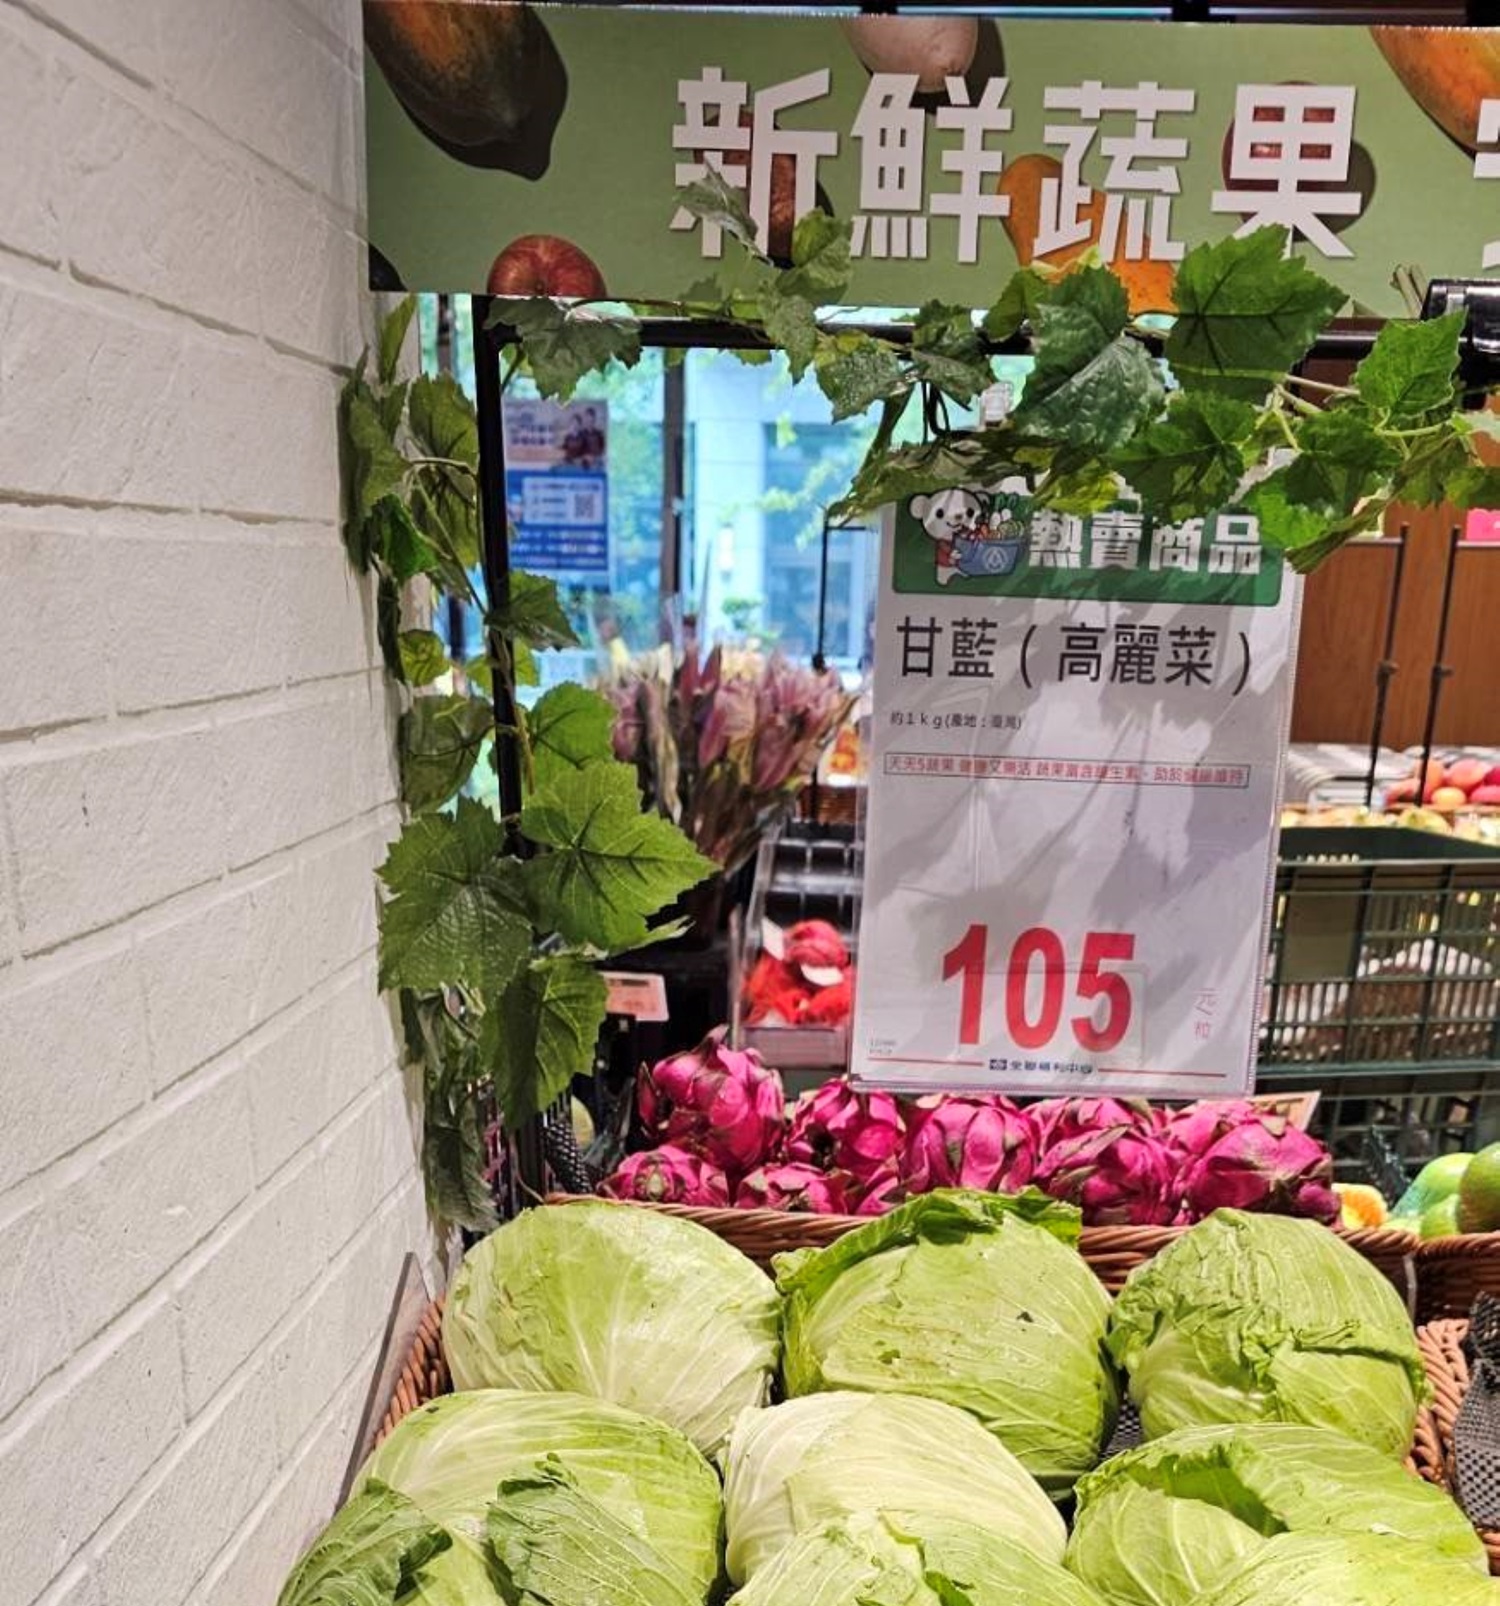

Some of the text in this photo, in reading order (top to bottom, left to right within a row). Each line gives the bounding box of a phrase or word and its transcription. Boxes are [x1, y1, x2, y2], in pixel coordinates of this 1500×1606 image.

[671, 66, 1363, 263] 新鮮蔬果
[1029, 508, 1262, 574] 熱賣商品
[942, 924, 1136, 1053] 105
